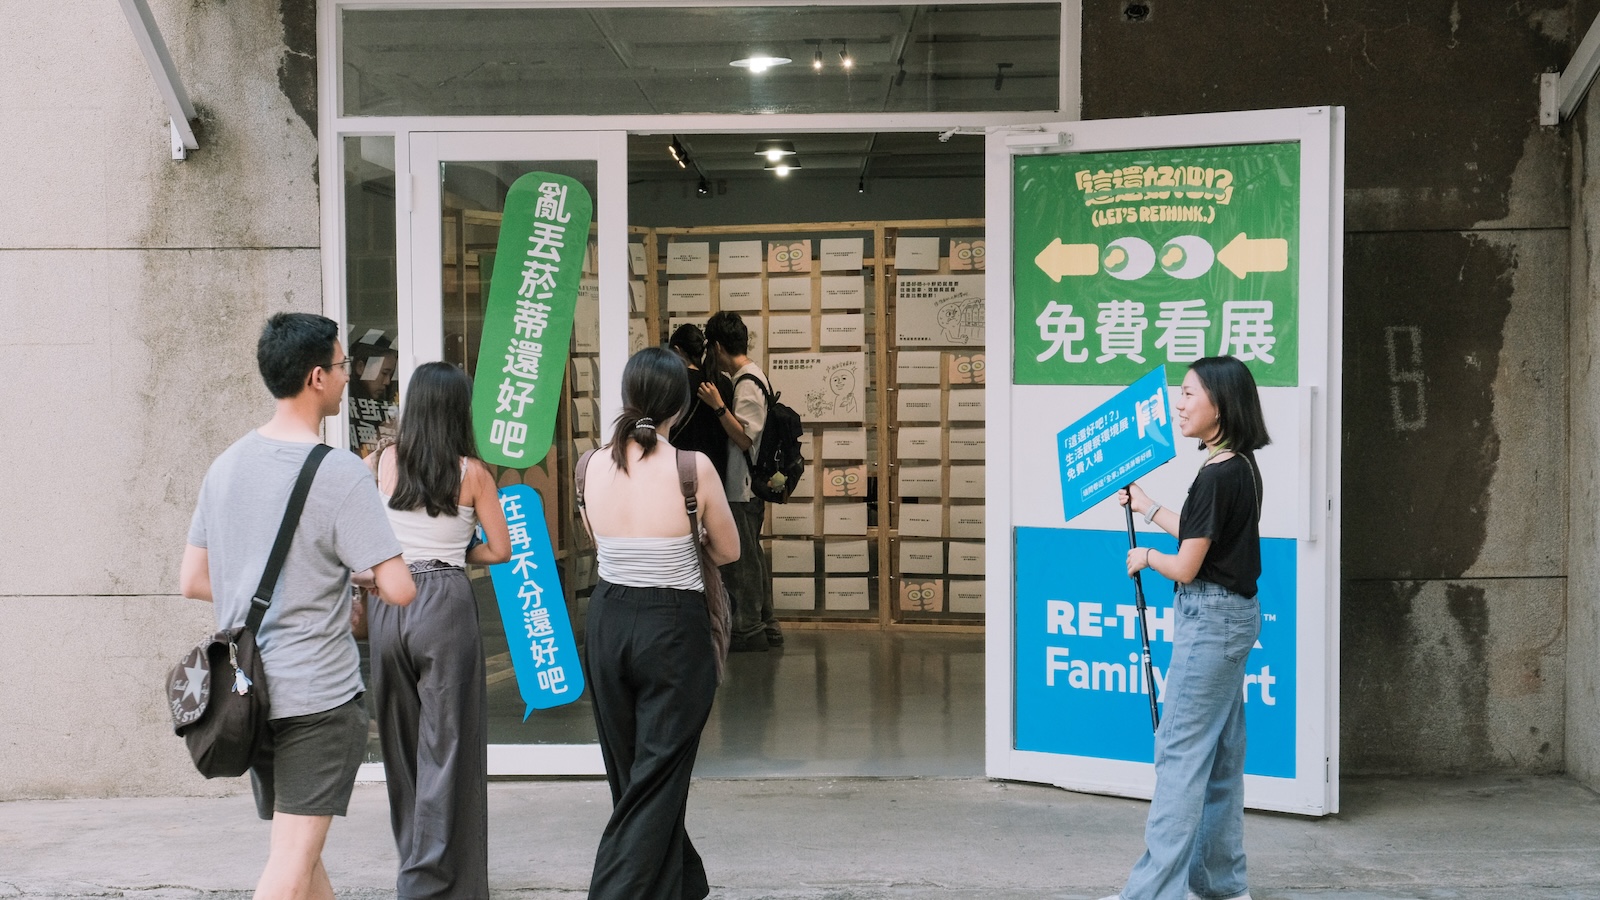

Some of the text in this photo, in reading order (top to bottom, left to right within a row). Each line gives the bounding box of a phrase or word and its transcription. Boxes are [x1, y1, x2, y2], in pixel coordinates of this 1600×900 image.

[1091, 206, 1139, 228] (LET'S
[489, 182, 571, 459] 亂丟菸蒂還好吧
[1035, 298, 1276, 365] 免費看展
[1066, 449, 1103, 482] 免費入場
[1046, 646, 1277, 706] Familyrt
